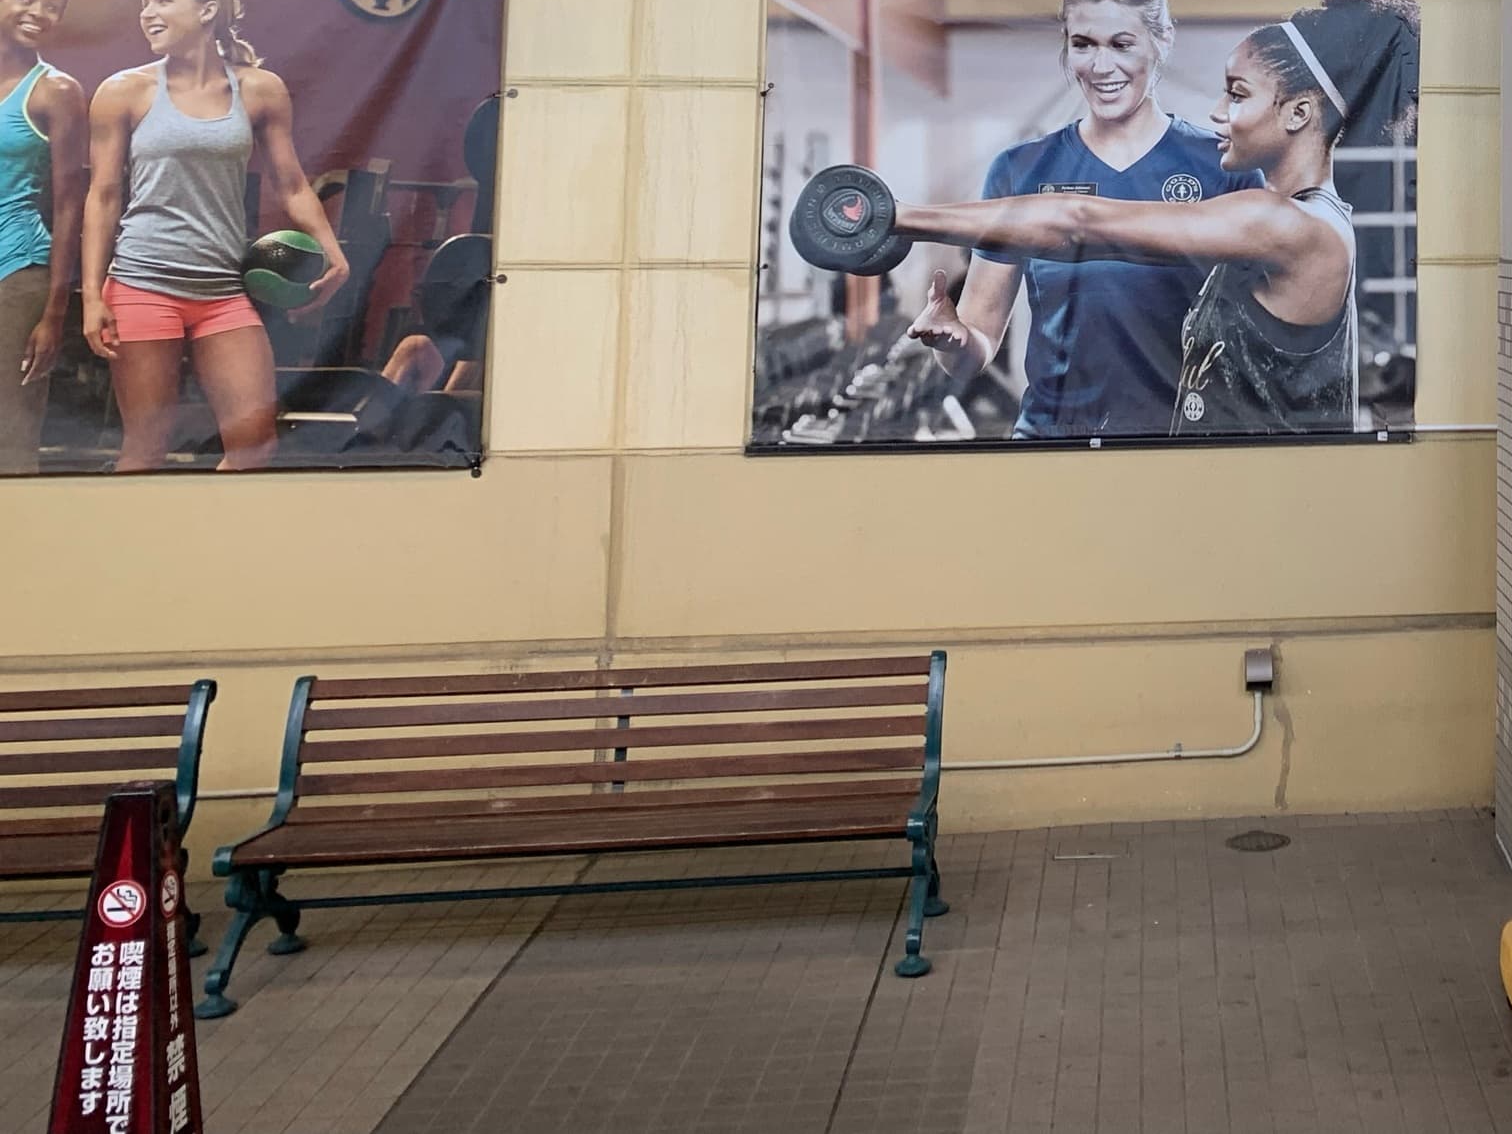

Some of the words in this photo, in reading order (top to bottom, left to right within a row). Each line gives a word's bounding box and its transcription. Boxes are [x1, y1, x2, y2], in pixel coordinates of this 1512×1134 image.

[79, 942, 116, 1115] お願い致します
[105, 941, 145, 1134] 喫煙は指定場所で
